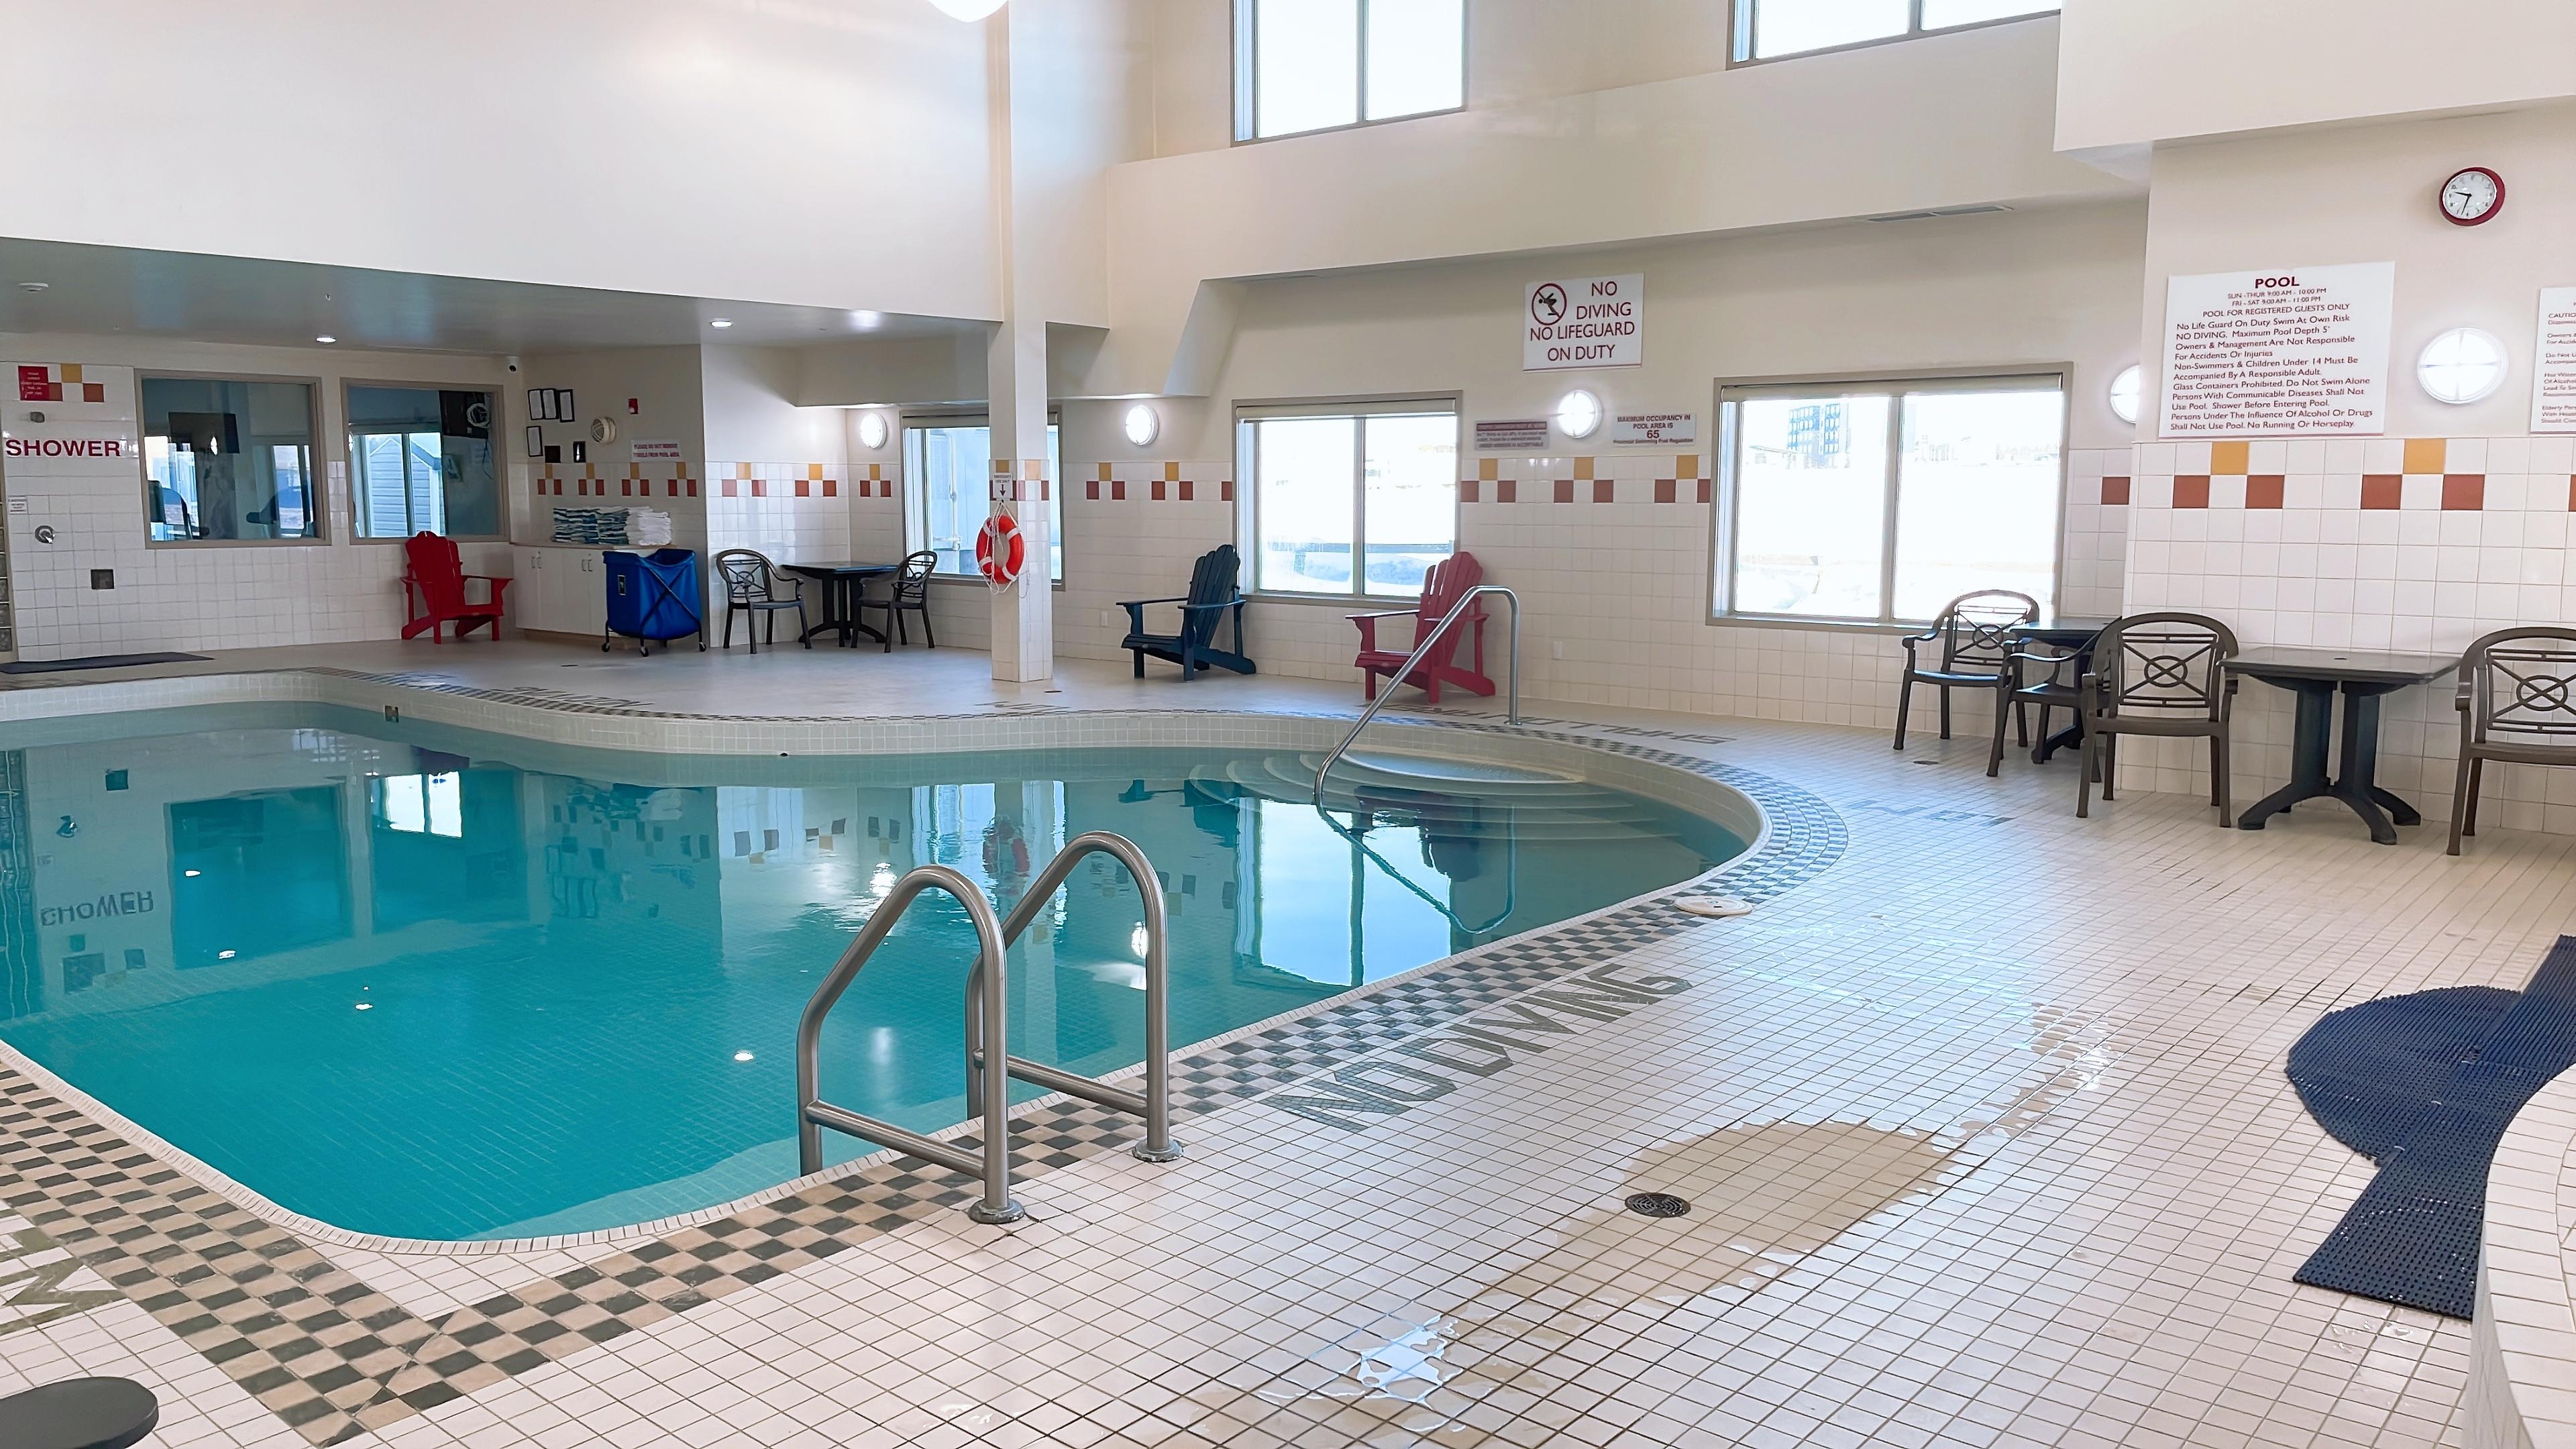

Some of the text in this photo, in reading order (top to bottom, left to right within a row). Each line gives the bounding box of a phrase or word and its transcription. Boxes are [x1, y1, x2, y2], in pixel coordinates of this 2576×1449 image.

[1591, 281, 1617, 297] NO
[2255, 276, 2300, 289] POOL
[1576, 302, 1631, 319] DIVING
[2245, 306, 2292, 315] REGISTERED
[1530, 321, 1635, 340] NO LIFEGUARD
[2295, 327, 2319, 335] Depth
[2218, 339, 2267, 349] Management
[2306, 336, 2355, 345] Responsible
[1548, 345, 1615, 361] ON DUTY
[2174, 372, 2225, 381] Accompanied
[2229, 372, 2238, 380] By
[2249, 369, 2296, 378] Responsible
[2226, 390, 2285, 398] Communicable
[2348, 409, 2373, 417] Drugs
[2263, 421, 2294, 429] Running
[1647, 430, 1660, 438] 65
[5, 439, 121, 457] SHOWER
[1265, 962, 1693, 1133] NO DIVING
